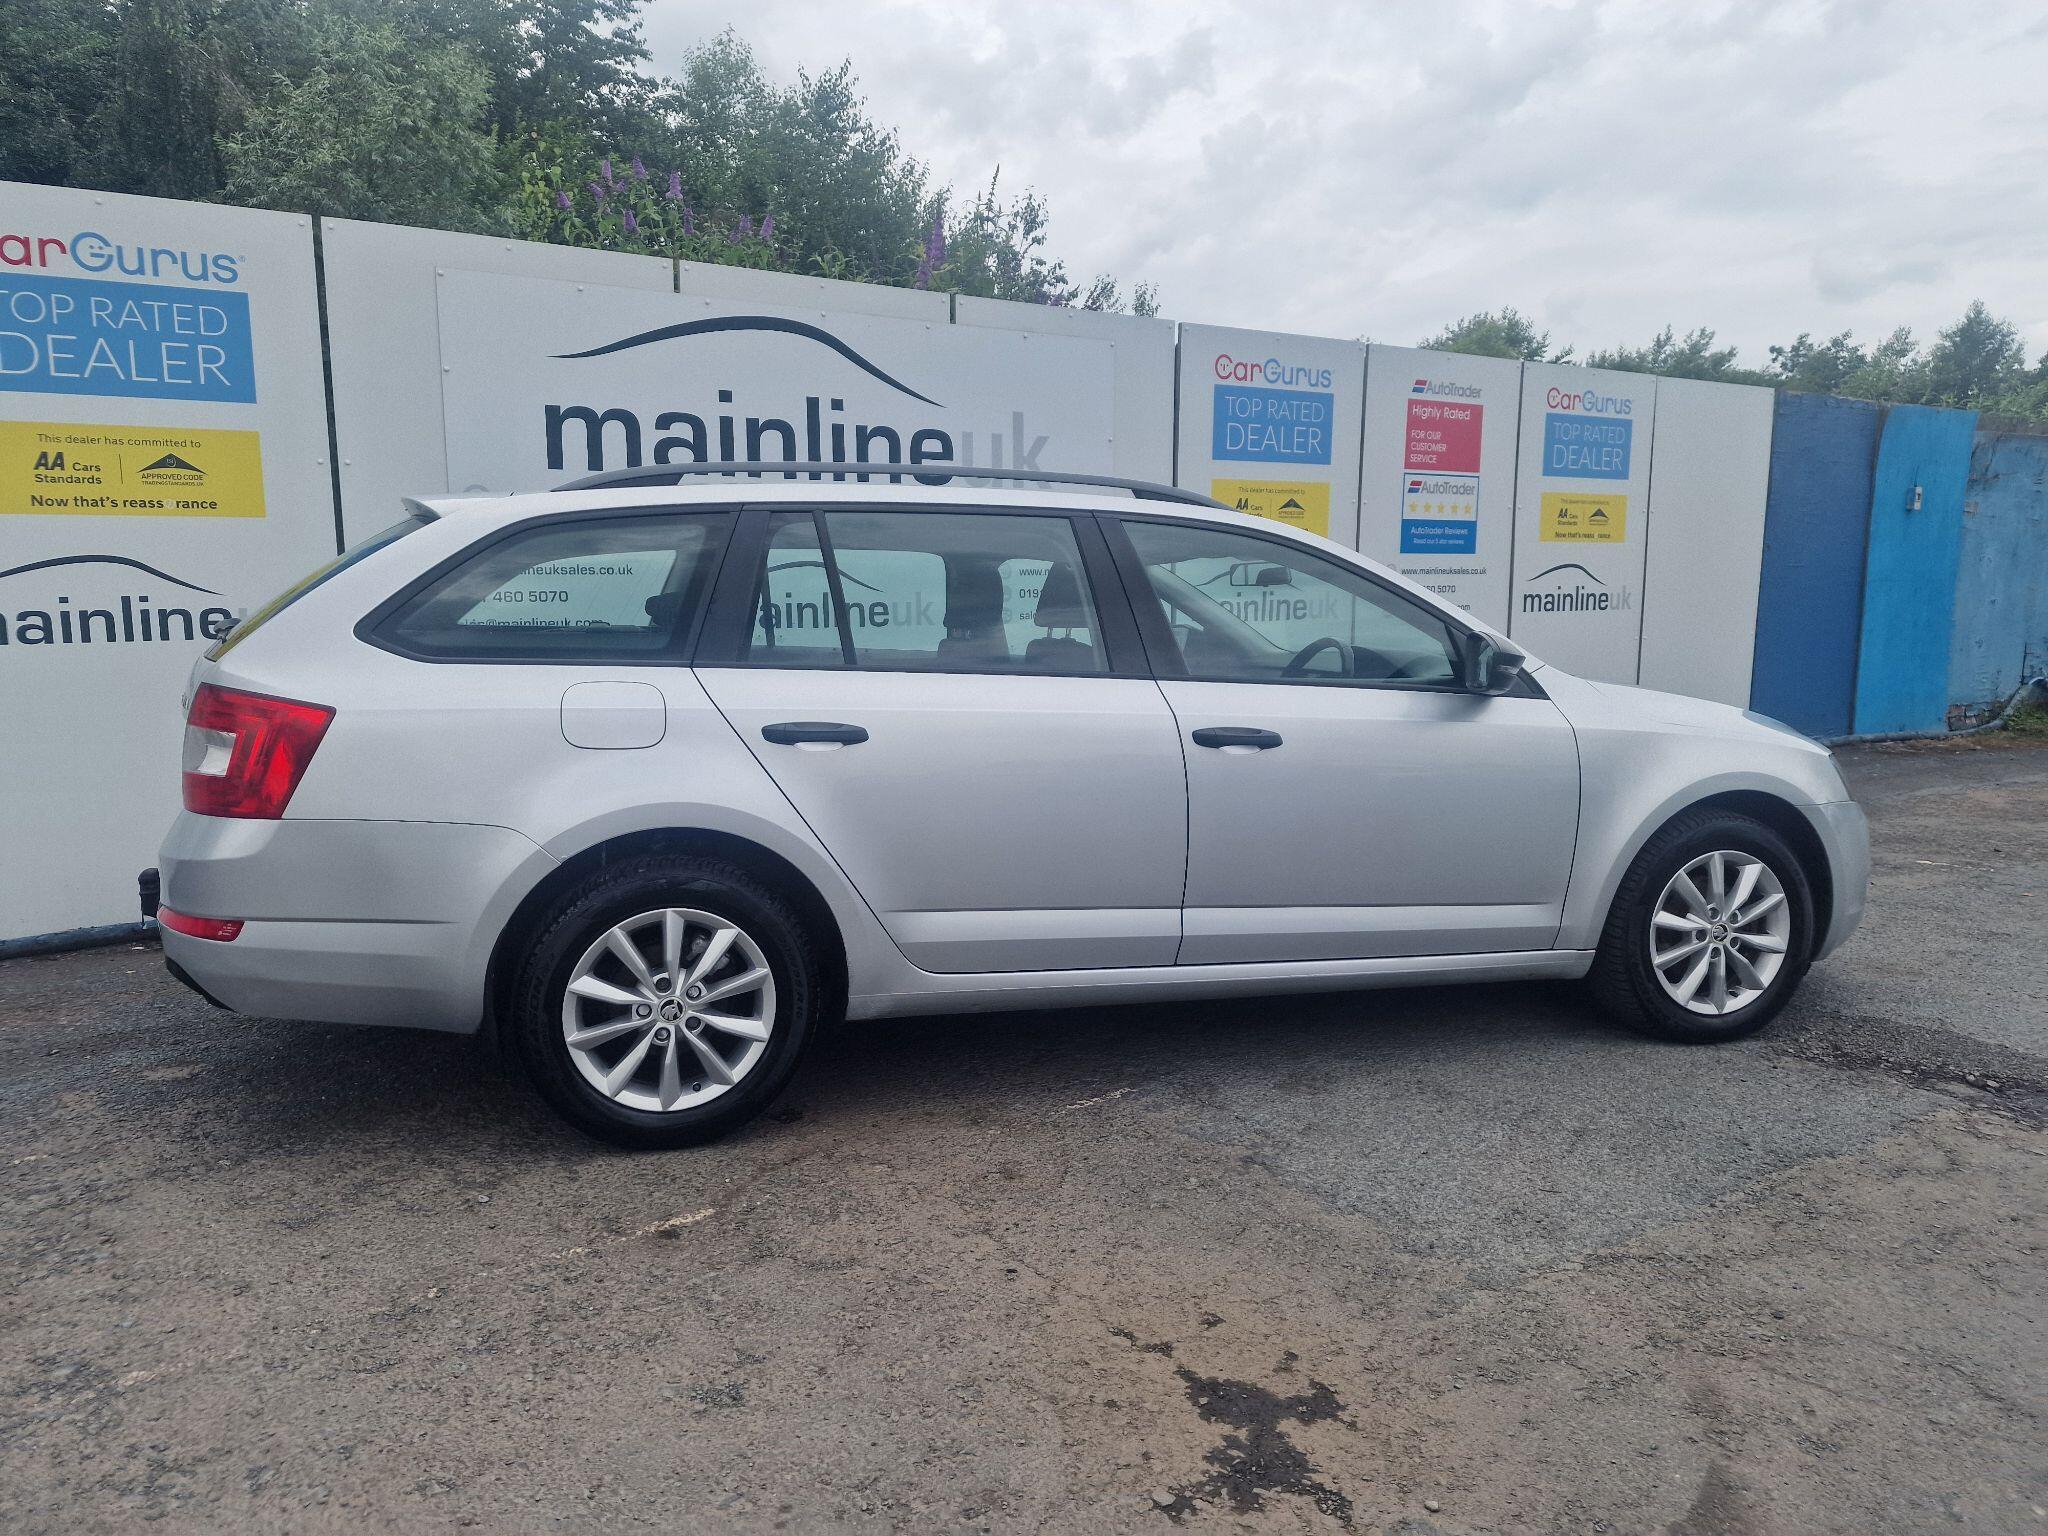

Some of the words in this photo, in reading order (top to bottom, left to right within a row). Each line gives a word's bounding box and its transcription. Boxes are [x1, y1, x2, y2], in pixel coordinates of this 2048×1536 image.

[0, 232, 239, 283] arGurus
[90, 297, 228, 336] RATED
[0, 331, 231, 386] DEALER
[1215, 354, 1331, 388] CarGurus
[1426, 381, 1482, 398] AutoTrader
[1225, 396, 1262, 418] TOP
[1268, 399, 1324, 422] RATED
[1547, 387, 1632, 414] CarGurus
[1412, 404, 1441, 420] Highly
[1443, 406, 1470, 420] Rated
[37, 433, 61, 443] This
[65, 434, 101, 445] dealer
[105, 436, 124, 446] has
[127, 437, 187, 448] committed
[191, 439, 201, 448] to
[1226, 422, 1322, 454] DEALER
[1411, 430, 1425, 439] FOR
[1427, 431, 1441, 440] OUR
[1553, 422, 1580, 440] TOP
[1584, 425, 1625, 444] RATED
[1411, 442, 1446, 452] CUSTOMER
[34, 451, 65, 471] AA
[73, 462, 101, 472] Cars
[1410, 453, 1437, 463] SERVICE
[1553, 445, 1623, 470] DEALER
[34, 474, 102, 484] Standards
[1421, 480, 1475, 495] AutoTrader
[31, 495, 68, 507] Now
[74, 496, 118, 508] that's
[123, 499, 217, 510] reassrance
[492, 590, 523, 602] 460
[528, 590, 569, 602] 5070
[1020, 588, 1041, 599] 019
[1437, 585, 1456, 593] 5070
[1523, 585, 1631, 612] mainlineuk
